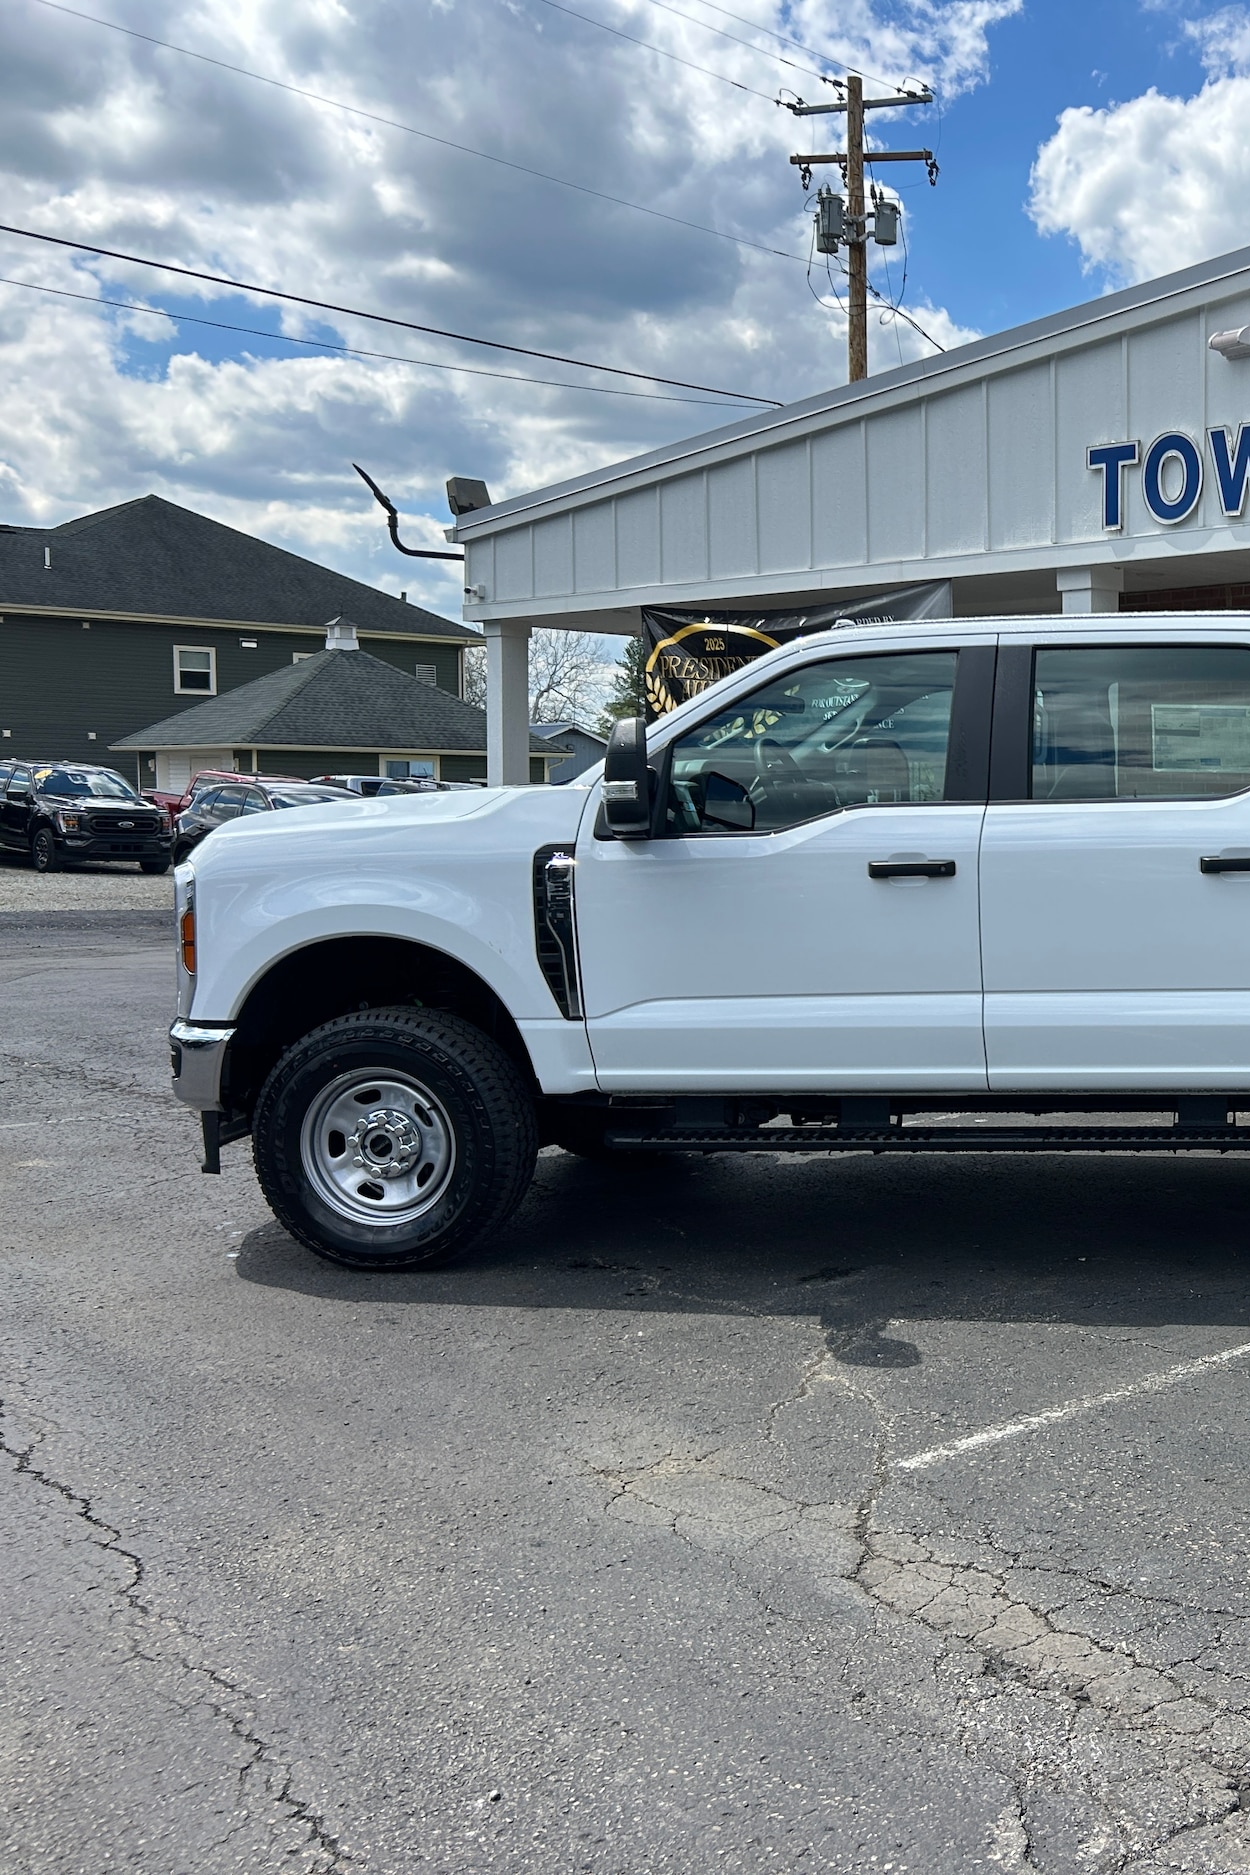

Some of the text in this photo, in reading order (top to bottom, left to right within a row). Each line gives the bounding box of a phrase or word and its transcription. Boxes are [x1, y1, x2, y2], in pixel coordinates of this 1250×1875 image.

[704, 637, 726, 651] 2025
[660, 655, 760, 680] PRESIDEN
[553, 851, 569, 859] XL
